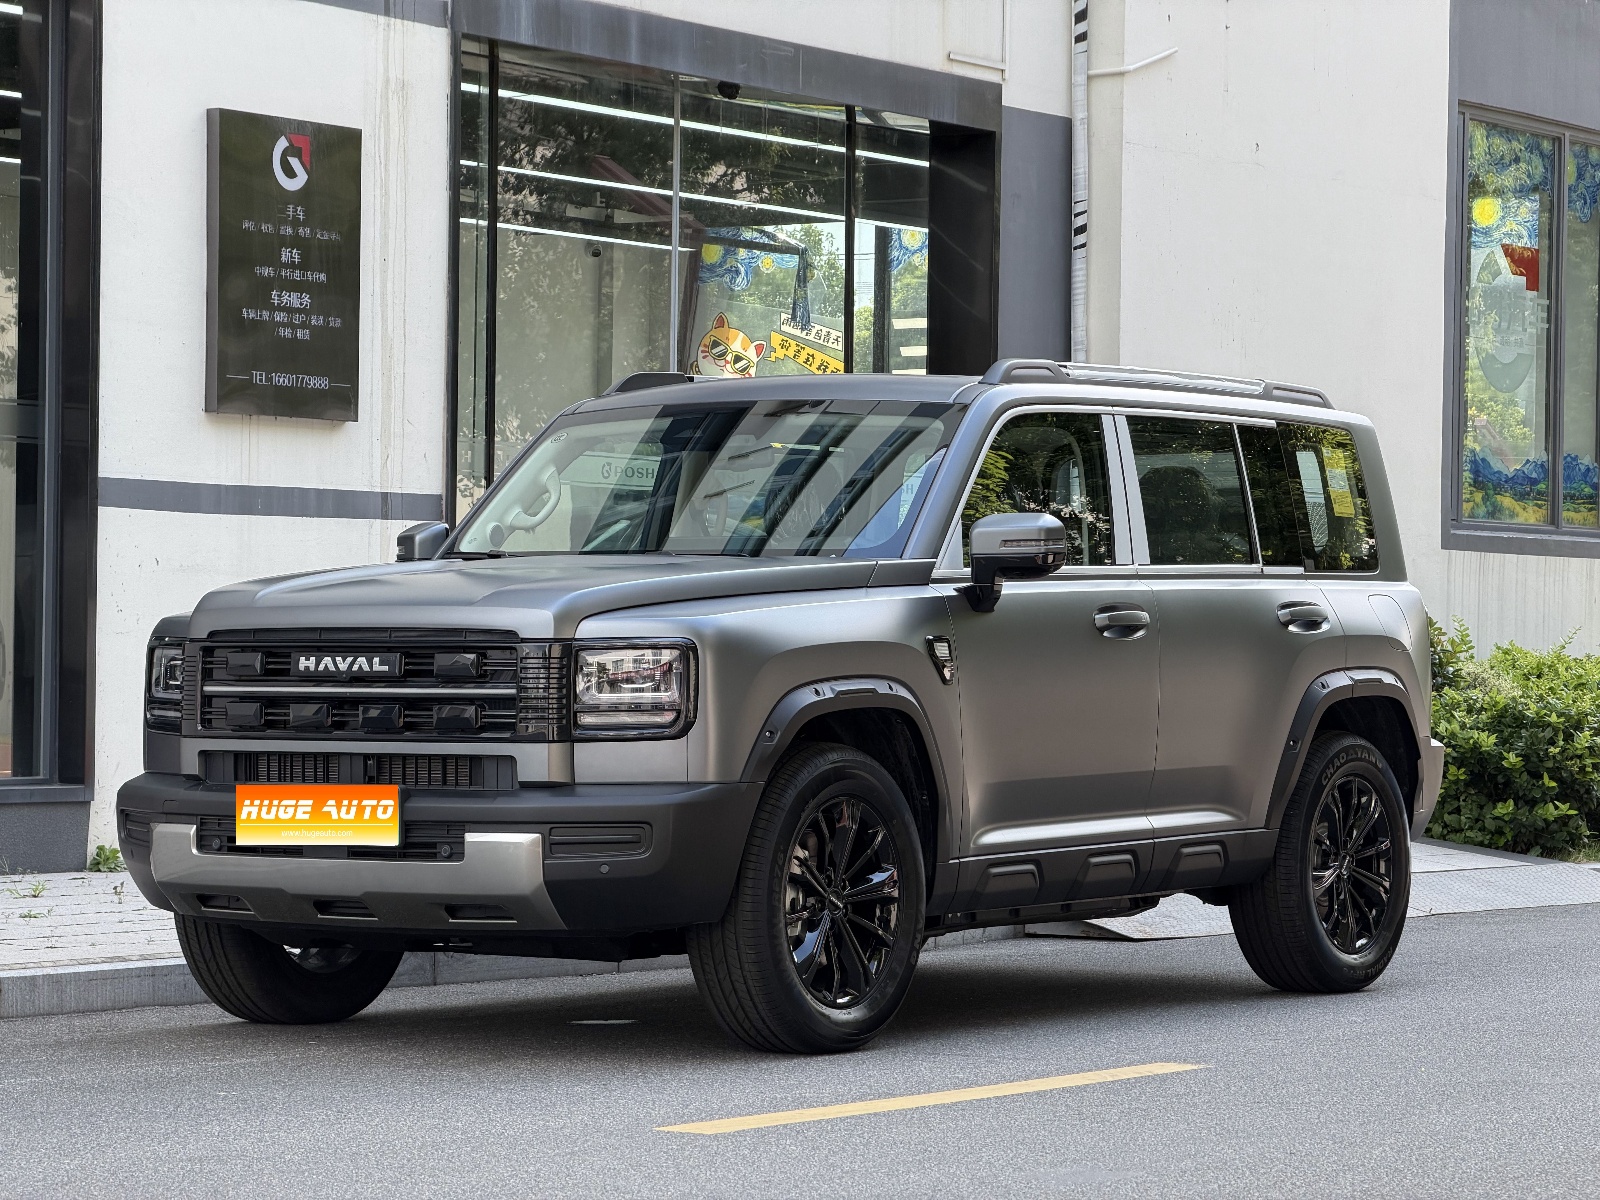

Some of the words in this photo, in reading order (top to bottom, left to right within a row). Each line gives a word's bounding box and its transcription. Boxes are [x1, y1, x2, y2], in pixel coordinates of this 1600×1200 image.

[277, 204, 306, 222] 二手车
[280, 247, 302, 264] 新车
[270, 290, 311, 309] 车务服务
[614, 466, 655, 478] POSH
[299, 656, 389, 672] HAVAL
